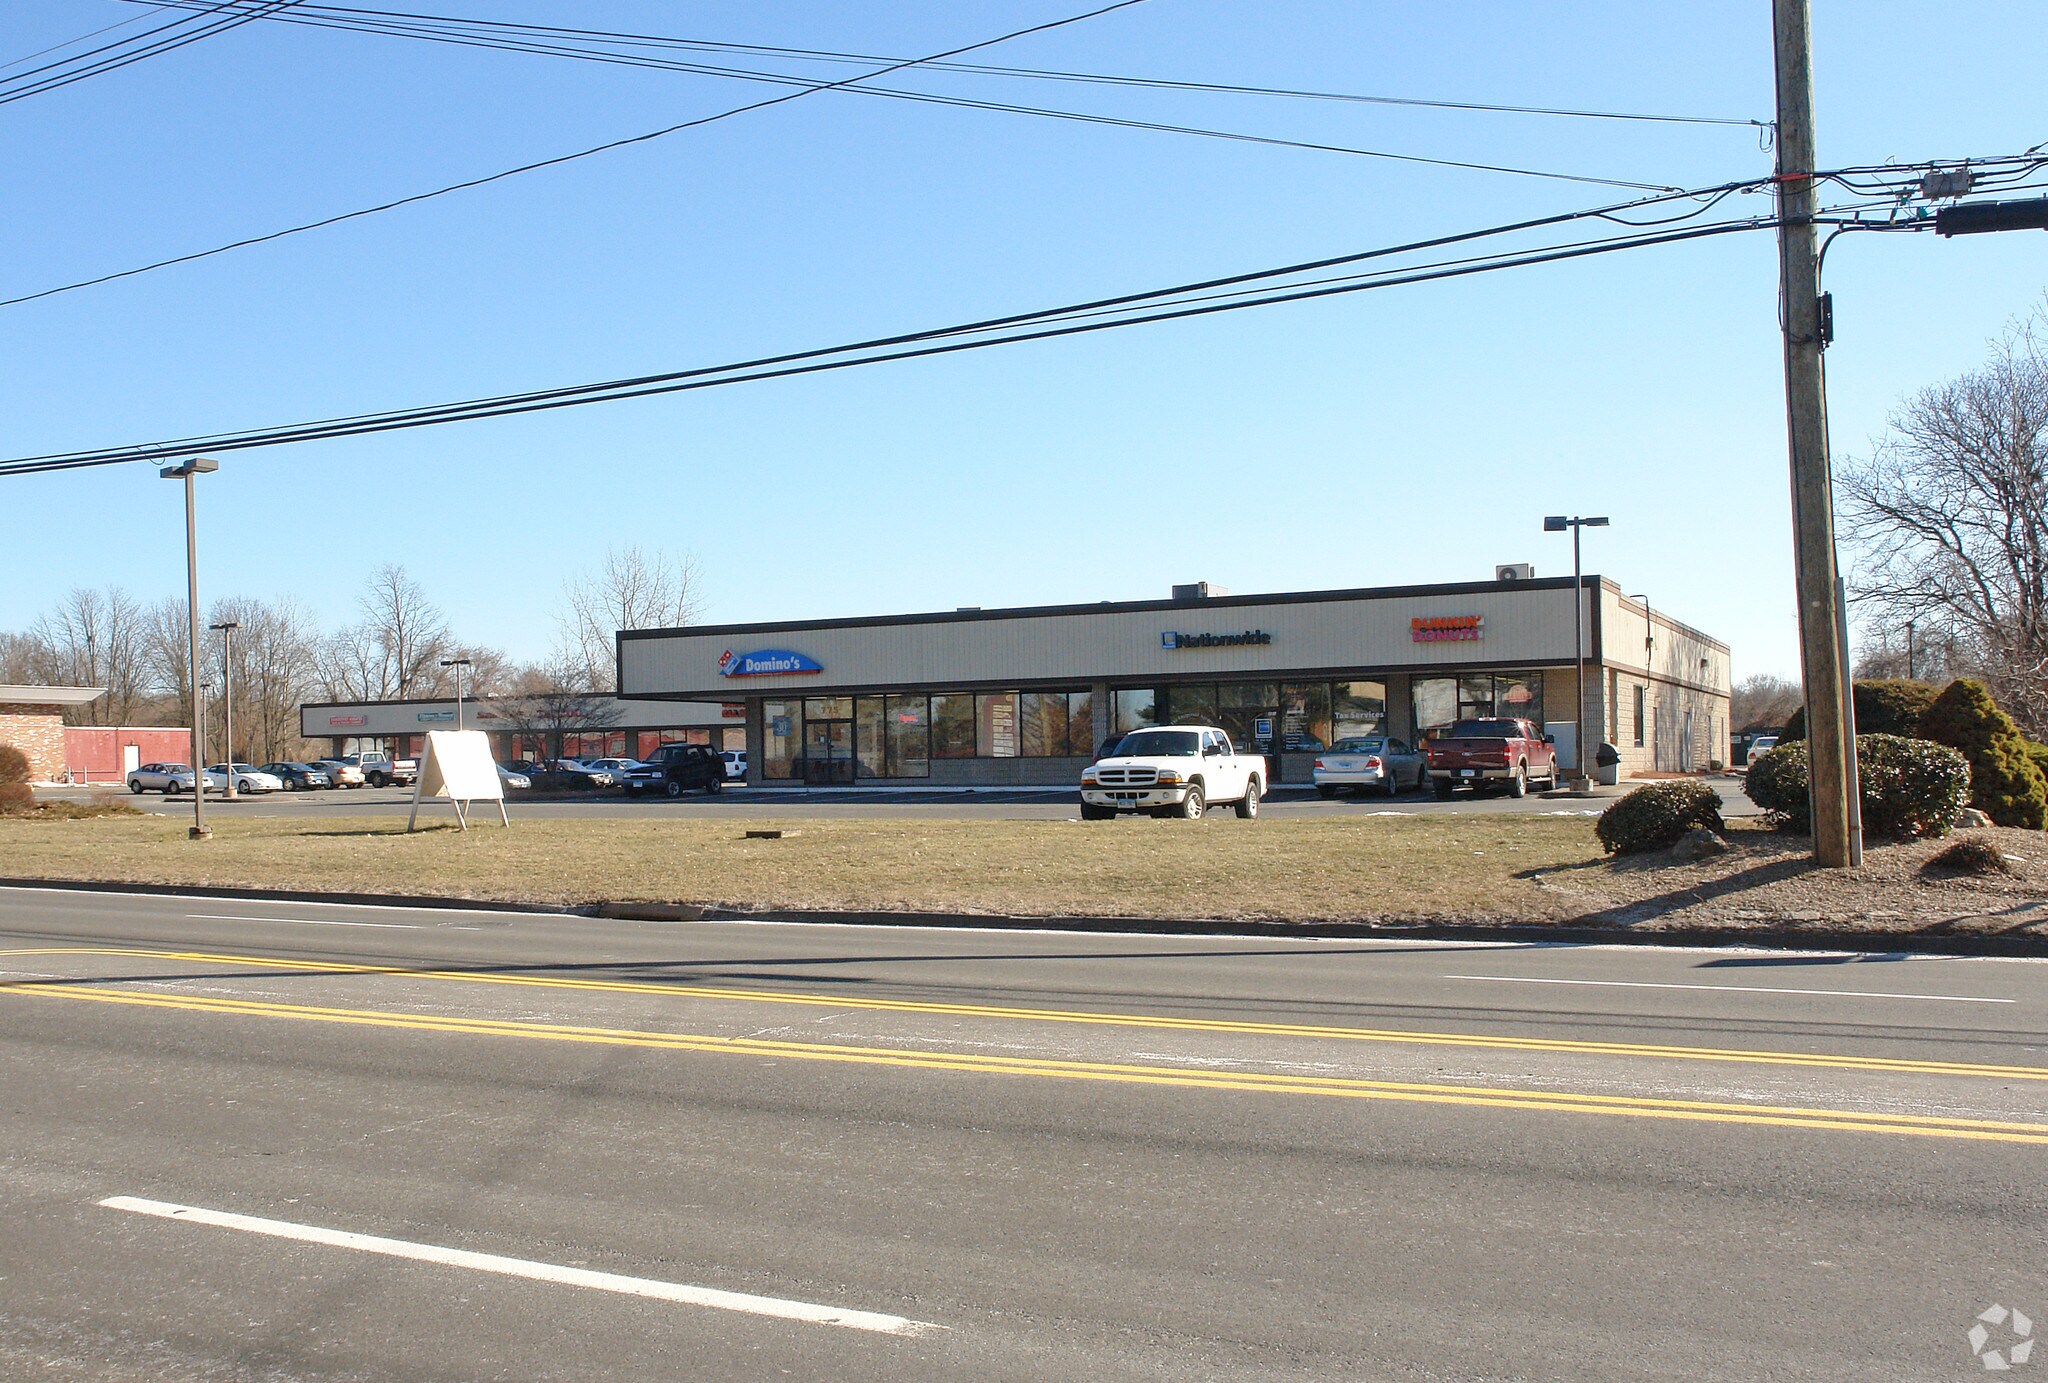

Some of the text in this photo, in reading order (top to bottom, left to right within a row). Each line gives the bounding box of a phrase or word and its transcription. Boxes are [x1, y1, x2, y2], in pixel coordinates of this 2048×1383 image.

[1411, 614, 1483, 630] DUNKIN'
[1412, 628, 1480, 642] DONUTS
[745, 656, 801, 672] Domino's
[821, 706, 839, 714] 775
[1334, 710, 1385, 719] Tax Services
